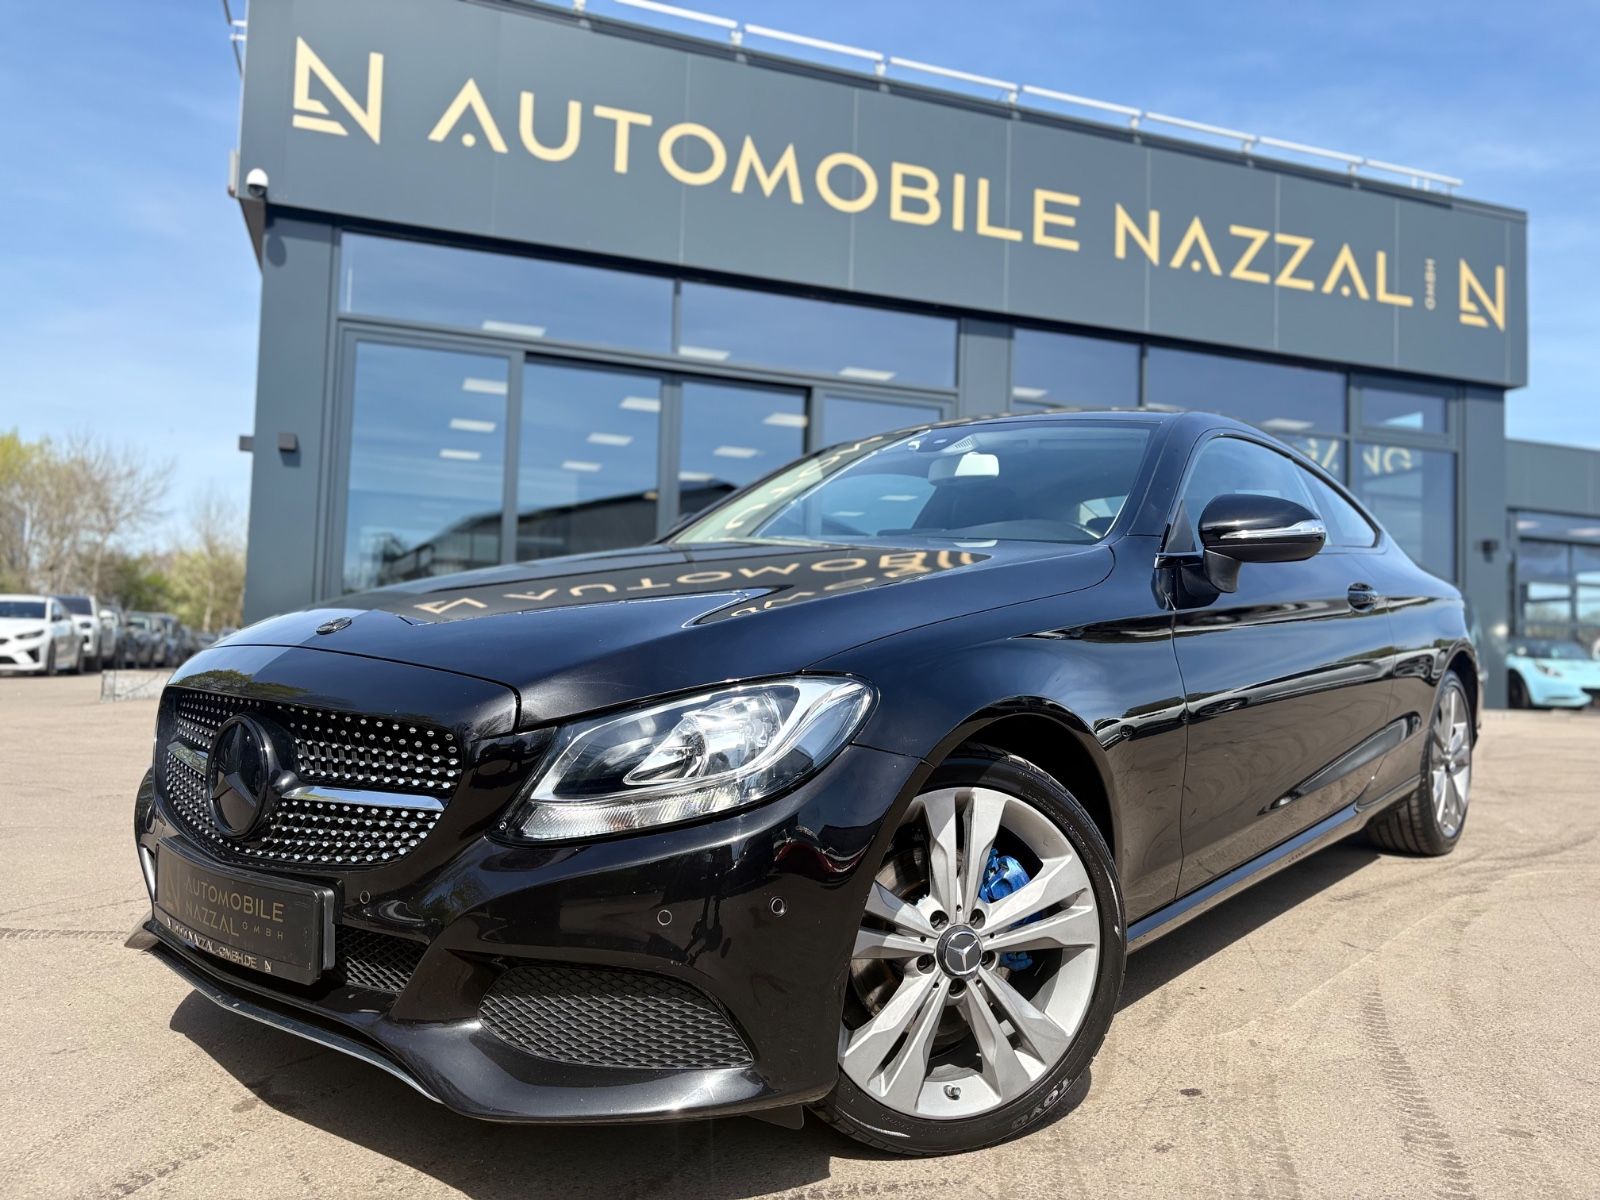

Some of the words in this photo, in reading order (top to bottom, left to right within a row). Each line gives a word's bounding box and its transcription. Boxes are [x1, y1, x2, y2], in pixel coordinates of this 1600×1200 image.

[428, 79, 1081, 252] AUTOMOBILE
[1115, 203, 1413, 308] NAZZAL
[184, 900, 240, 937] NAZZAL
[185, 876, 285, 923] AUTOMOBILE
